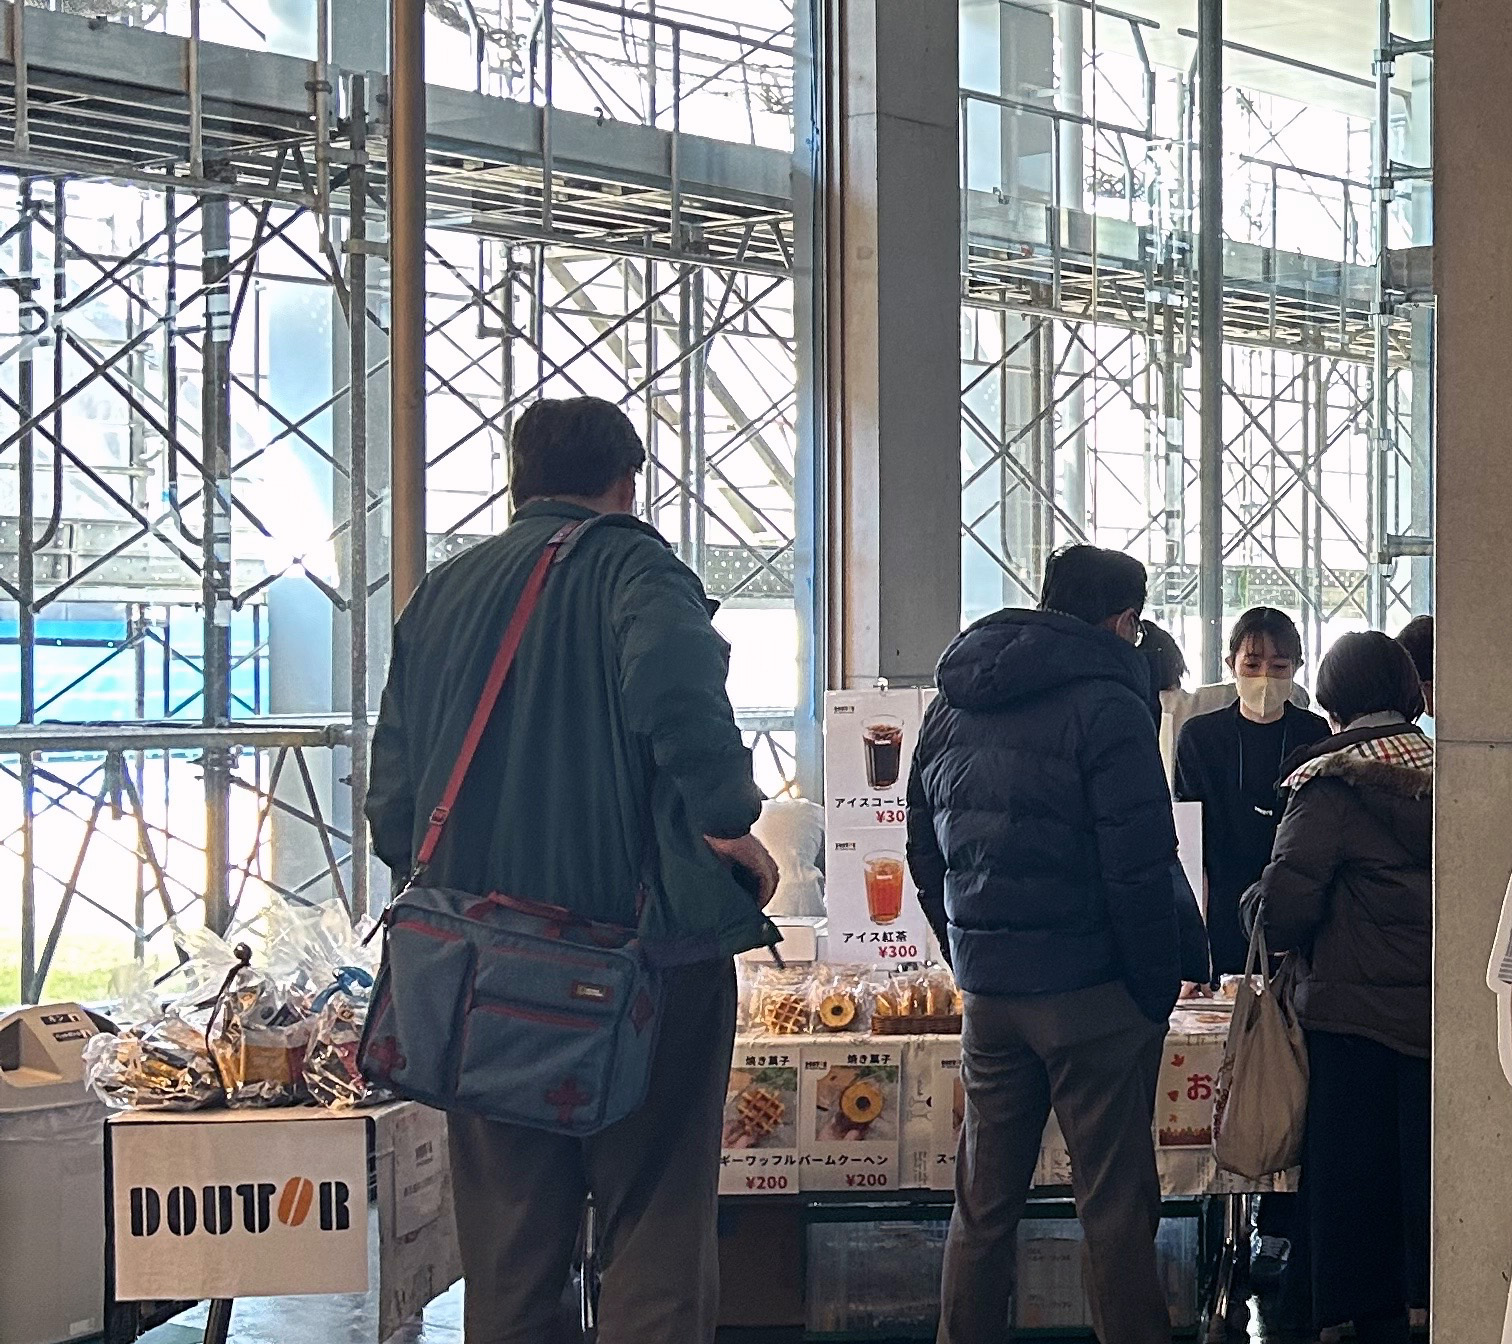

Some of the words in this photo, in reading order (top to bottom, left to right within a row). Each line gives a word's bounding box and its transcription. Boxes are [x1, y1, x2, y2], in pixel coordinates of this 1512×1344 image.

[834, 796, 906, 808] アイスコーヒ
[876, 810, 905, 823] ¥30
[842, 931, 908, 943] アイス紅茶
[878, 945, 918, 958] ¥300
[799, 1154, 888, 1165] バームクーヘン
[746, 1176, 788, 1189] ¥200
[846, 1174, 887, 1186] ¥200
[130, 1176, 350, 1237] DOUTOR
